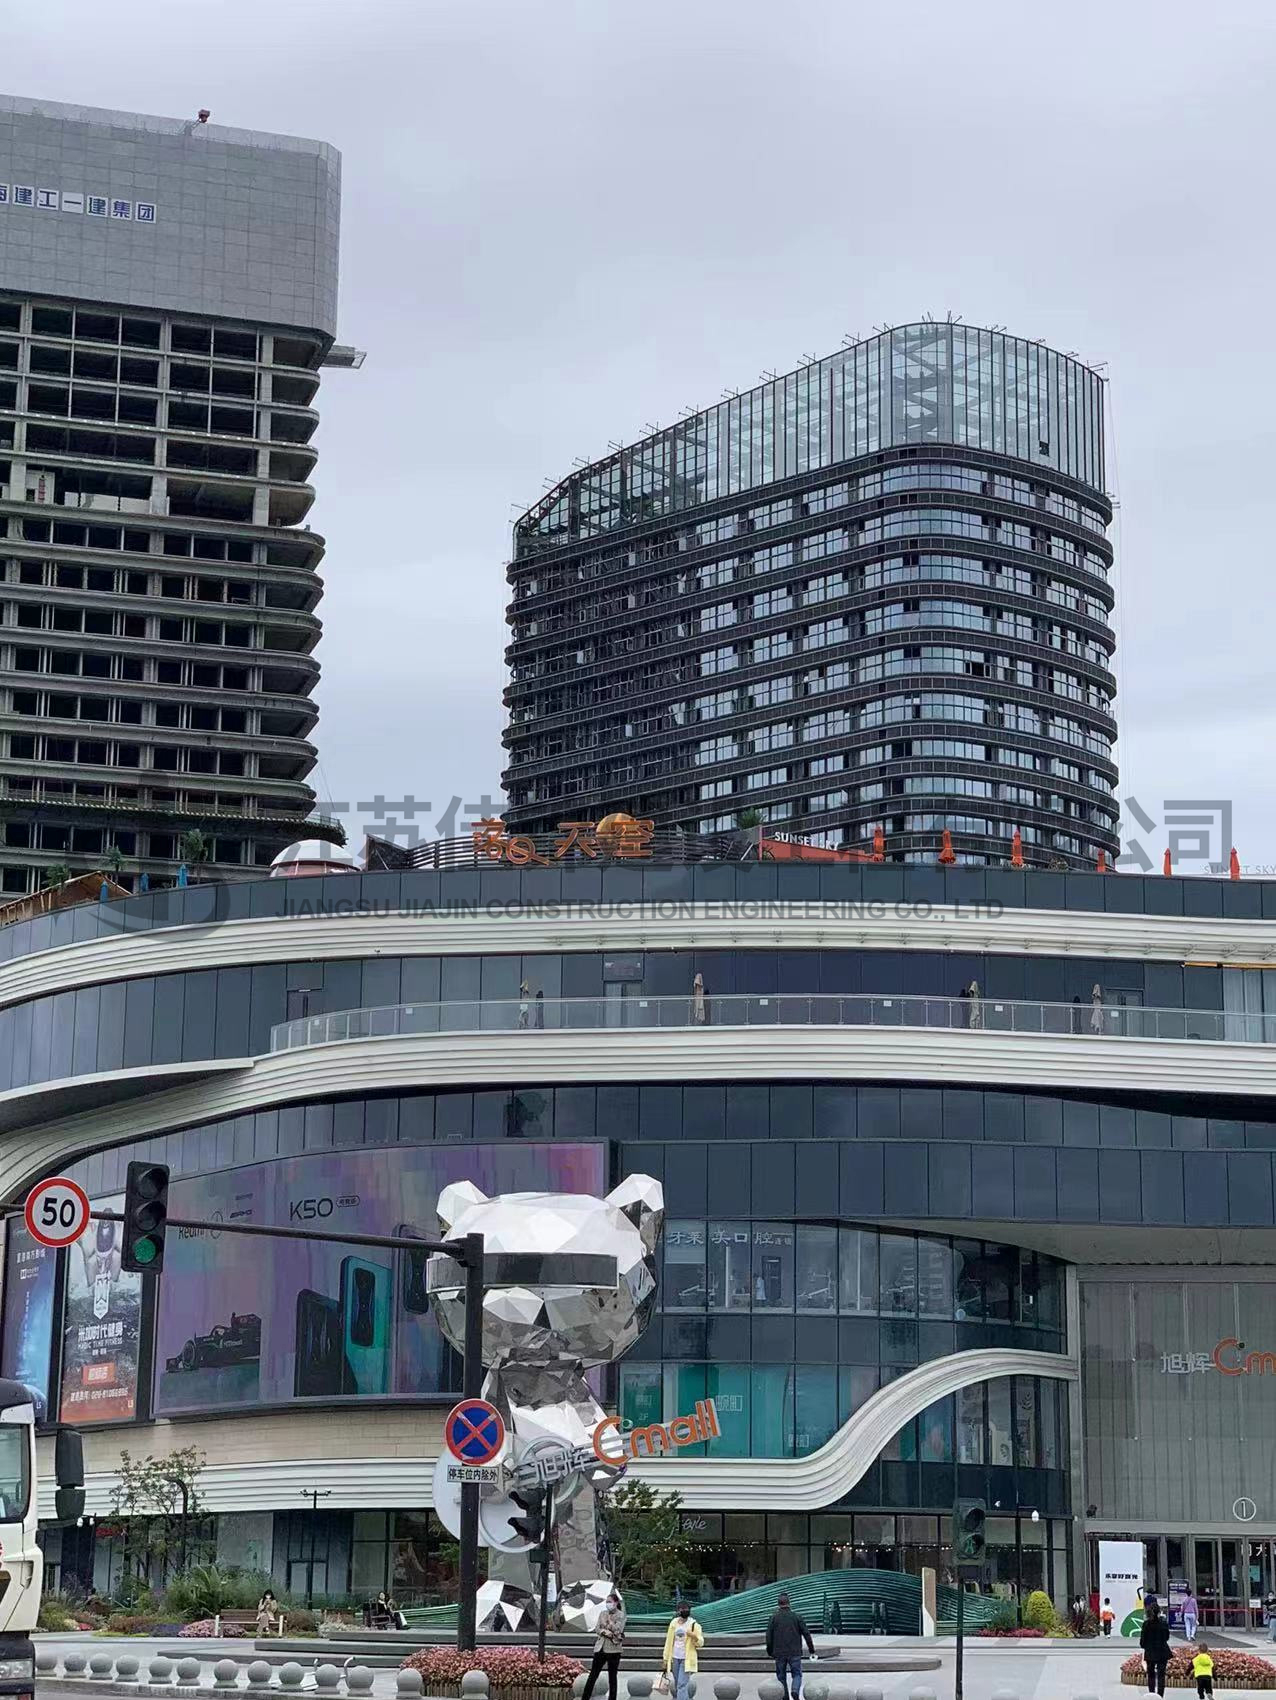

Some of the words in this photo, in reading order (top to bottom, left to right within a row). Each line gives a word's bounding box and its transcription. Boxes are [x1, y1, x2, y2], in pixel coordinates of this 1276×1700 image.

[41, 1197, 76, 1229] 50
[290, 1197, 334, 1221] K50
[448, 1467, 498, 1482] 停车位内除外
